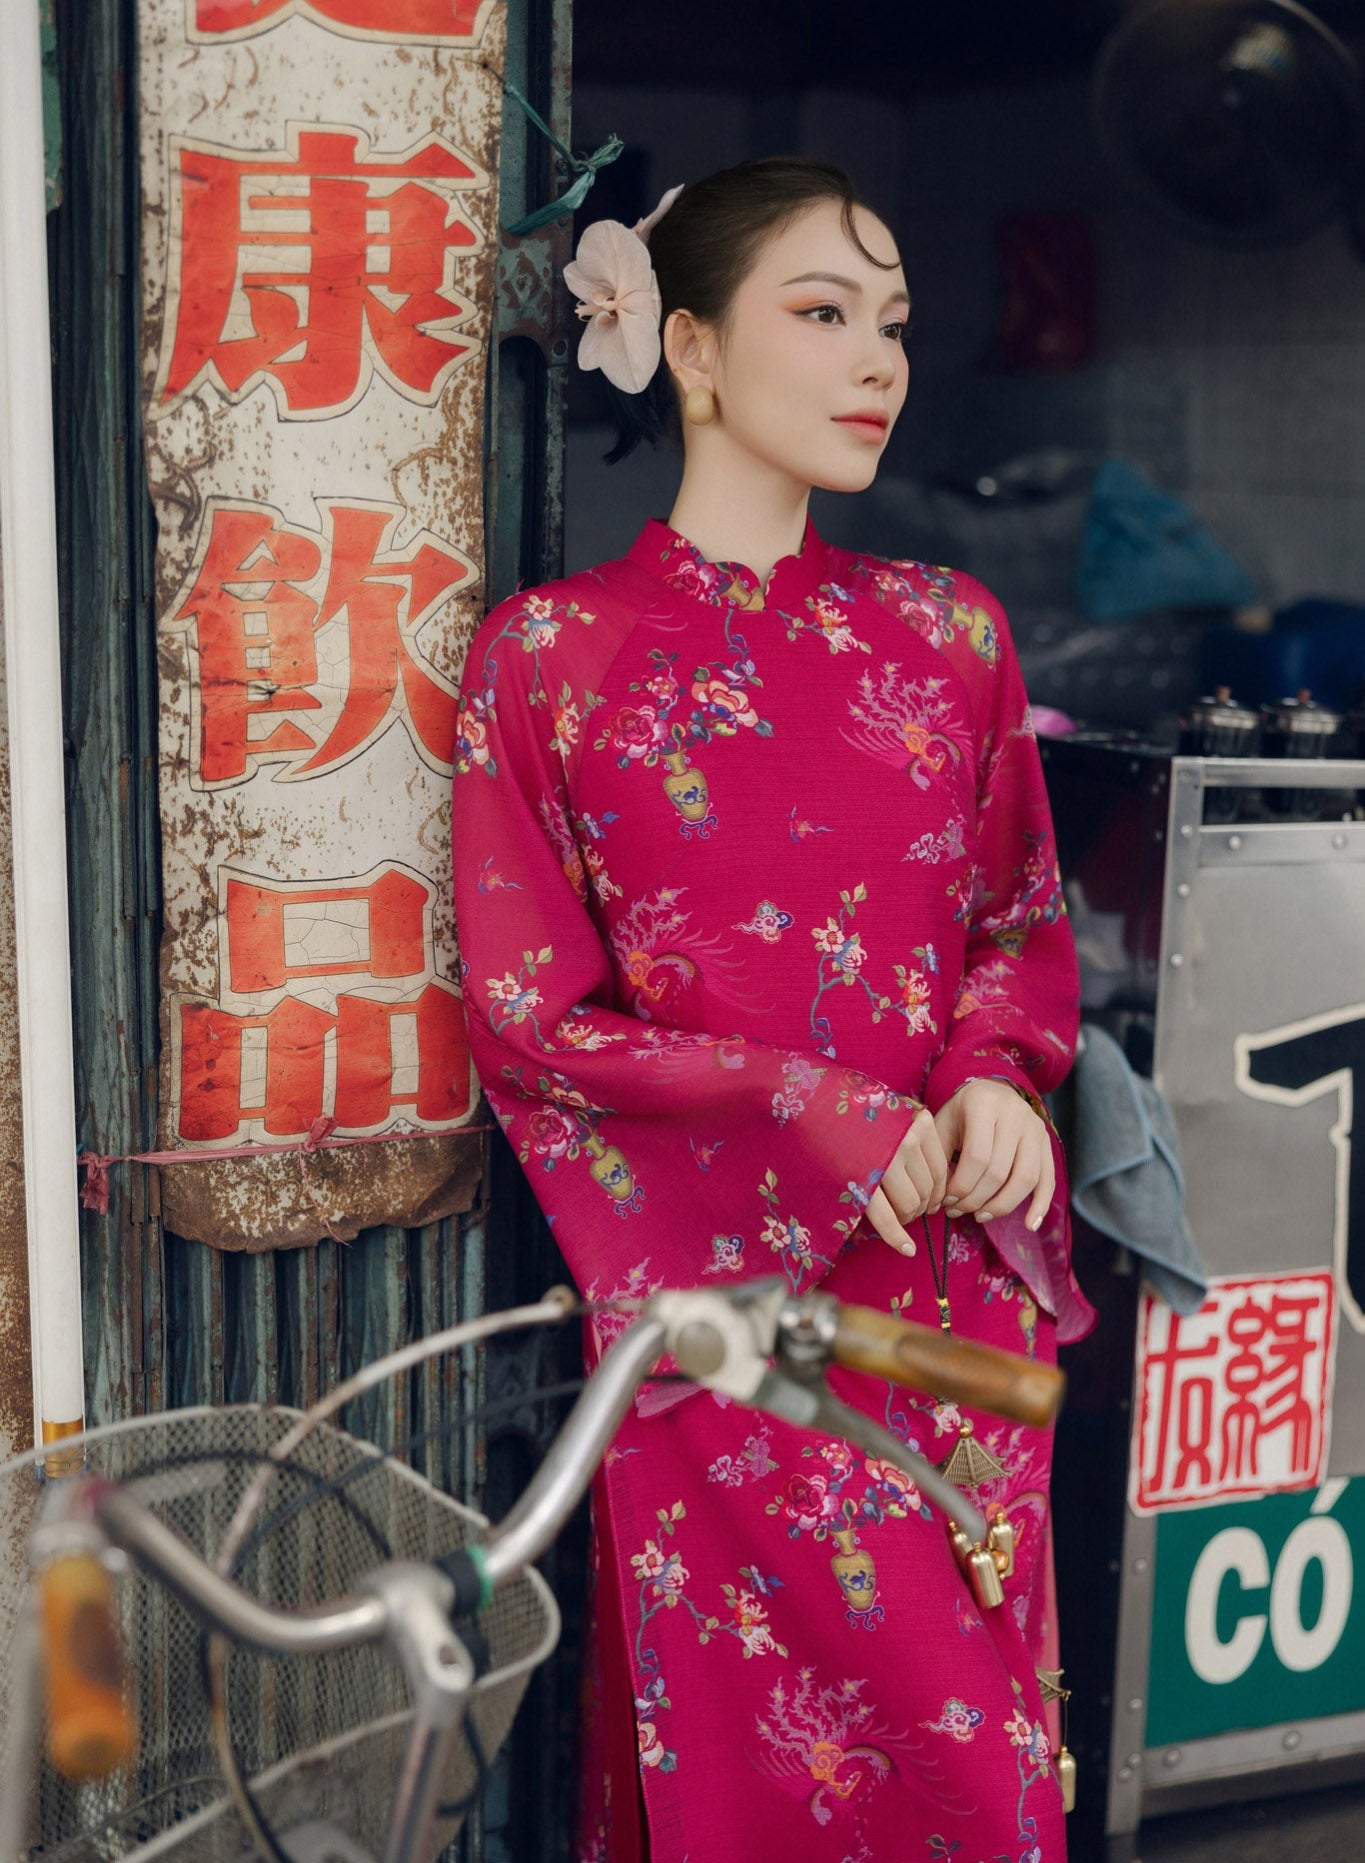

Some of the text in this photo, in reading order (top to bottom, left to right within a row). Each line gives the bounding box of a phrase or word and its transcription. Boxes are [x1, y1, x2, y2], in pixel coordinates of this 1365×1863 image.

[155, 0, 486, 1142] 康飲品
[1184, 1476, 1354, 1685] CÓ
